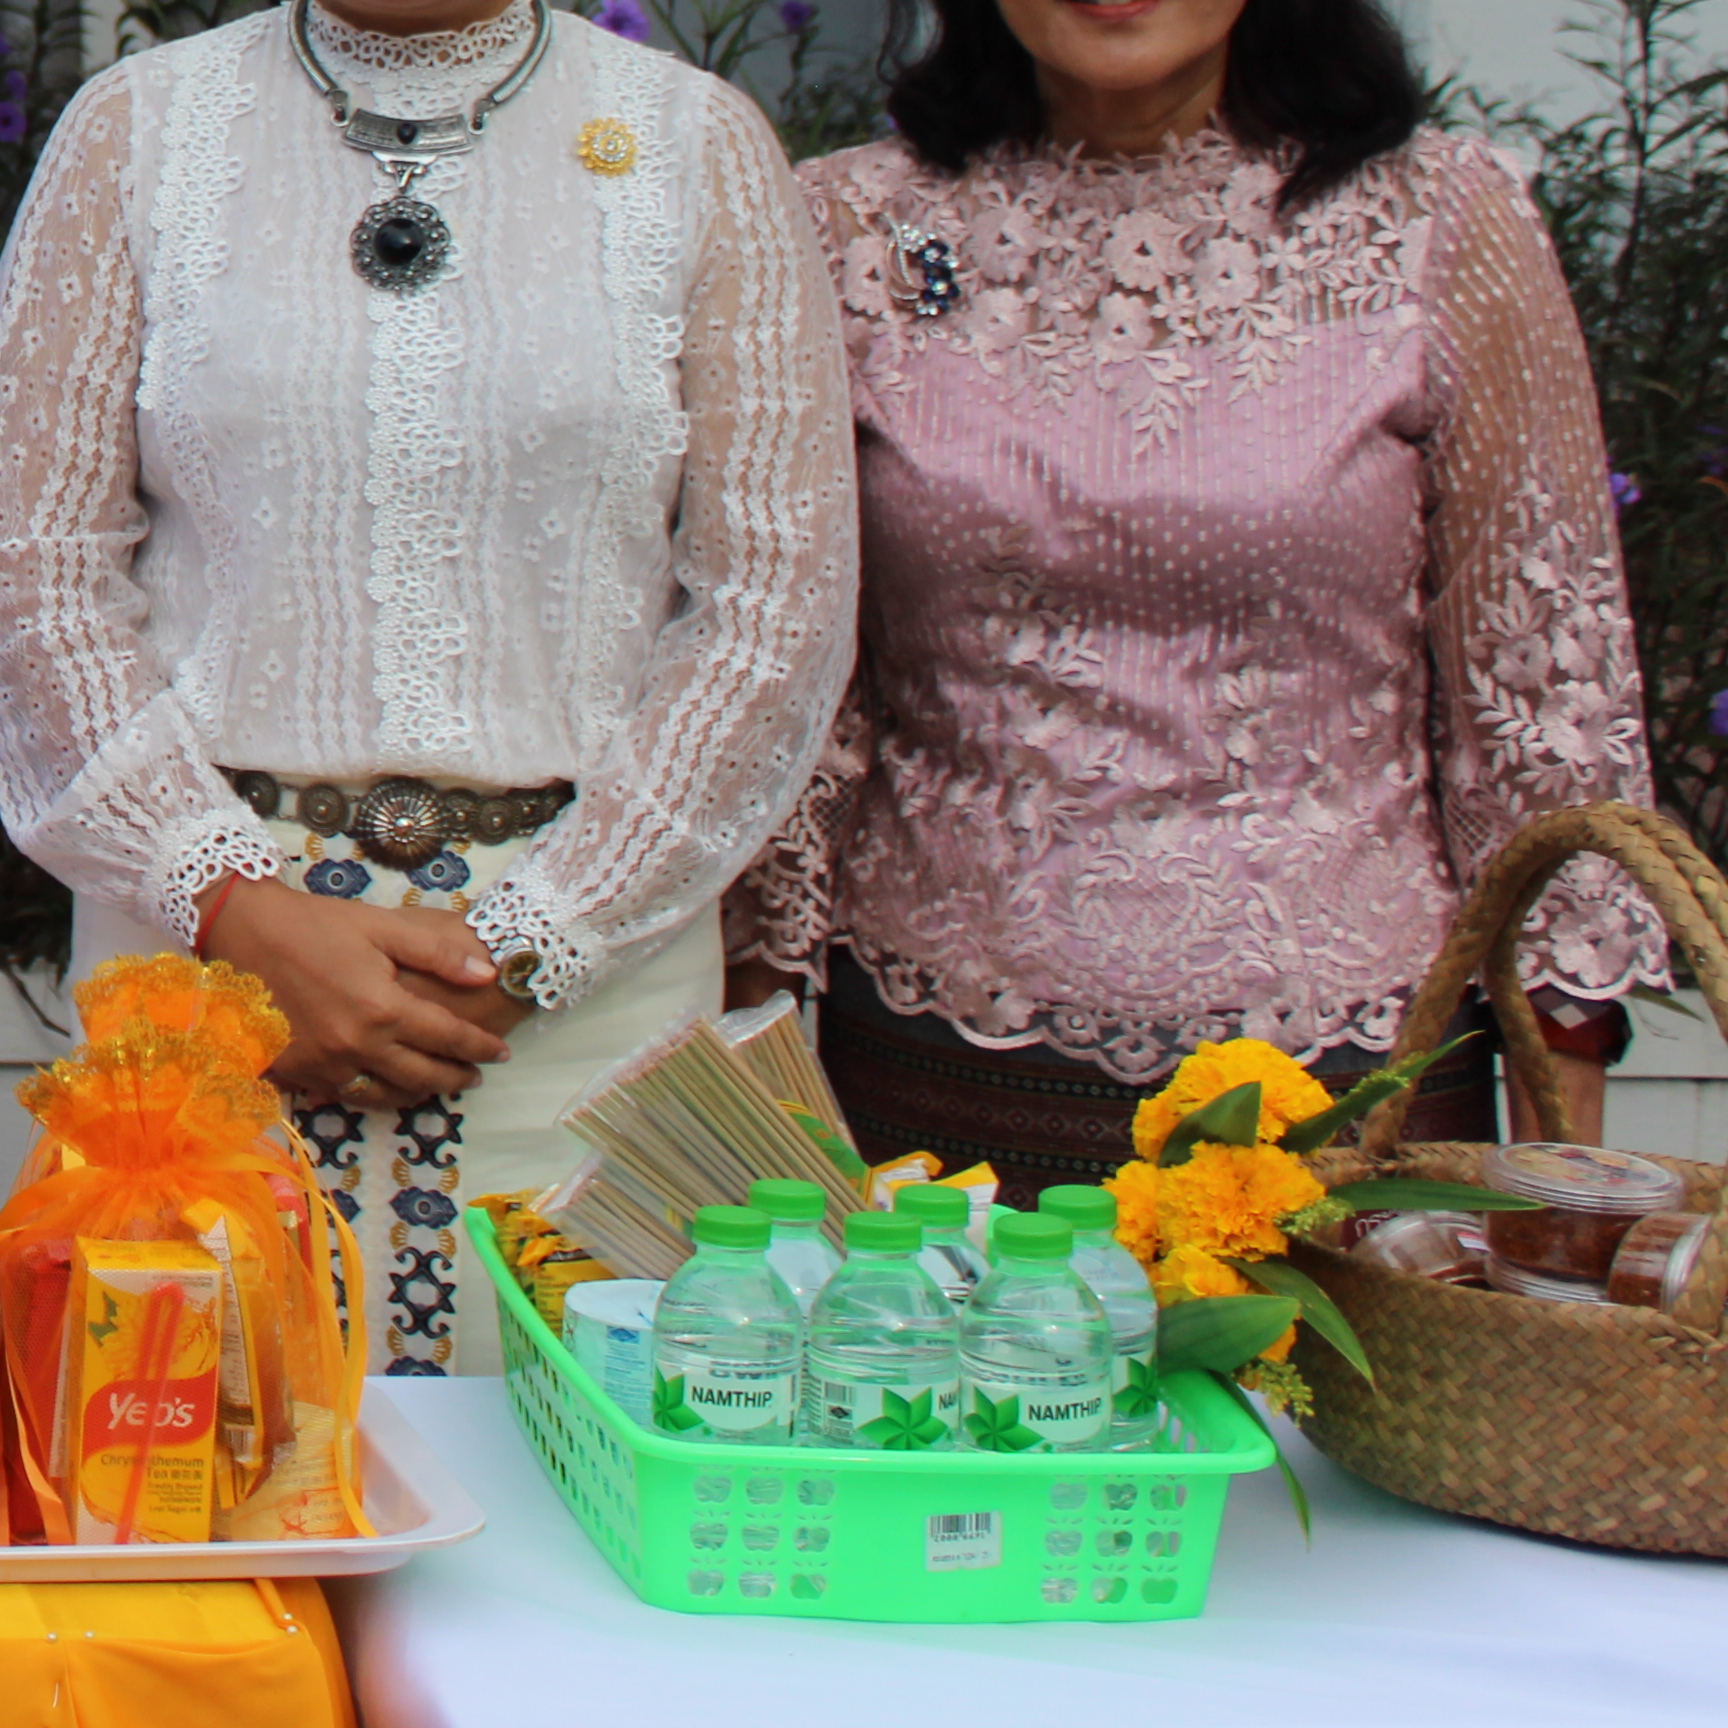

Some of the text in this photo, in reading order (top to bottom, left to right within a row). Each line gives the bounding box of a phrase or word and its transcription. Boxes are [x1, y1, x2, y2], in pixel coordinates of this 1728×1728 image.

[691, 1385, 773, 1408] NAMTHIP
[1028, 1396, 1102, 1422] NAMTHIP
[107, 1392, 196, 1430] Yeo's
